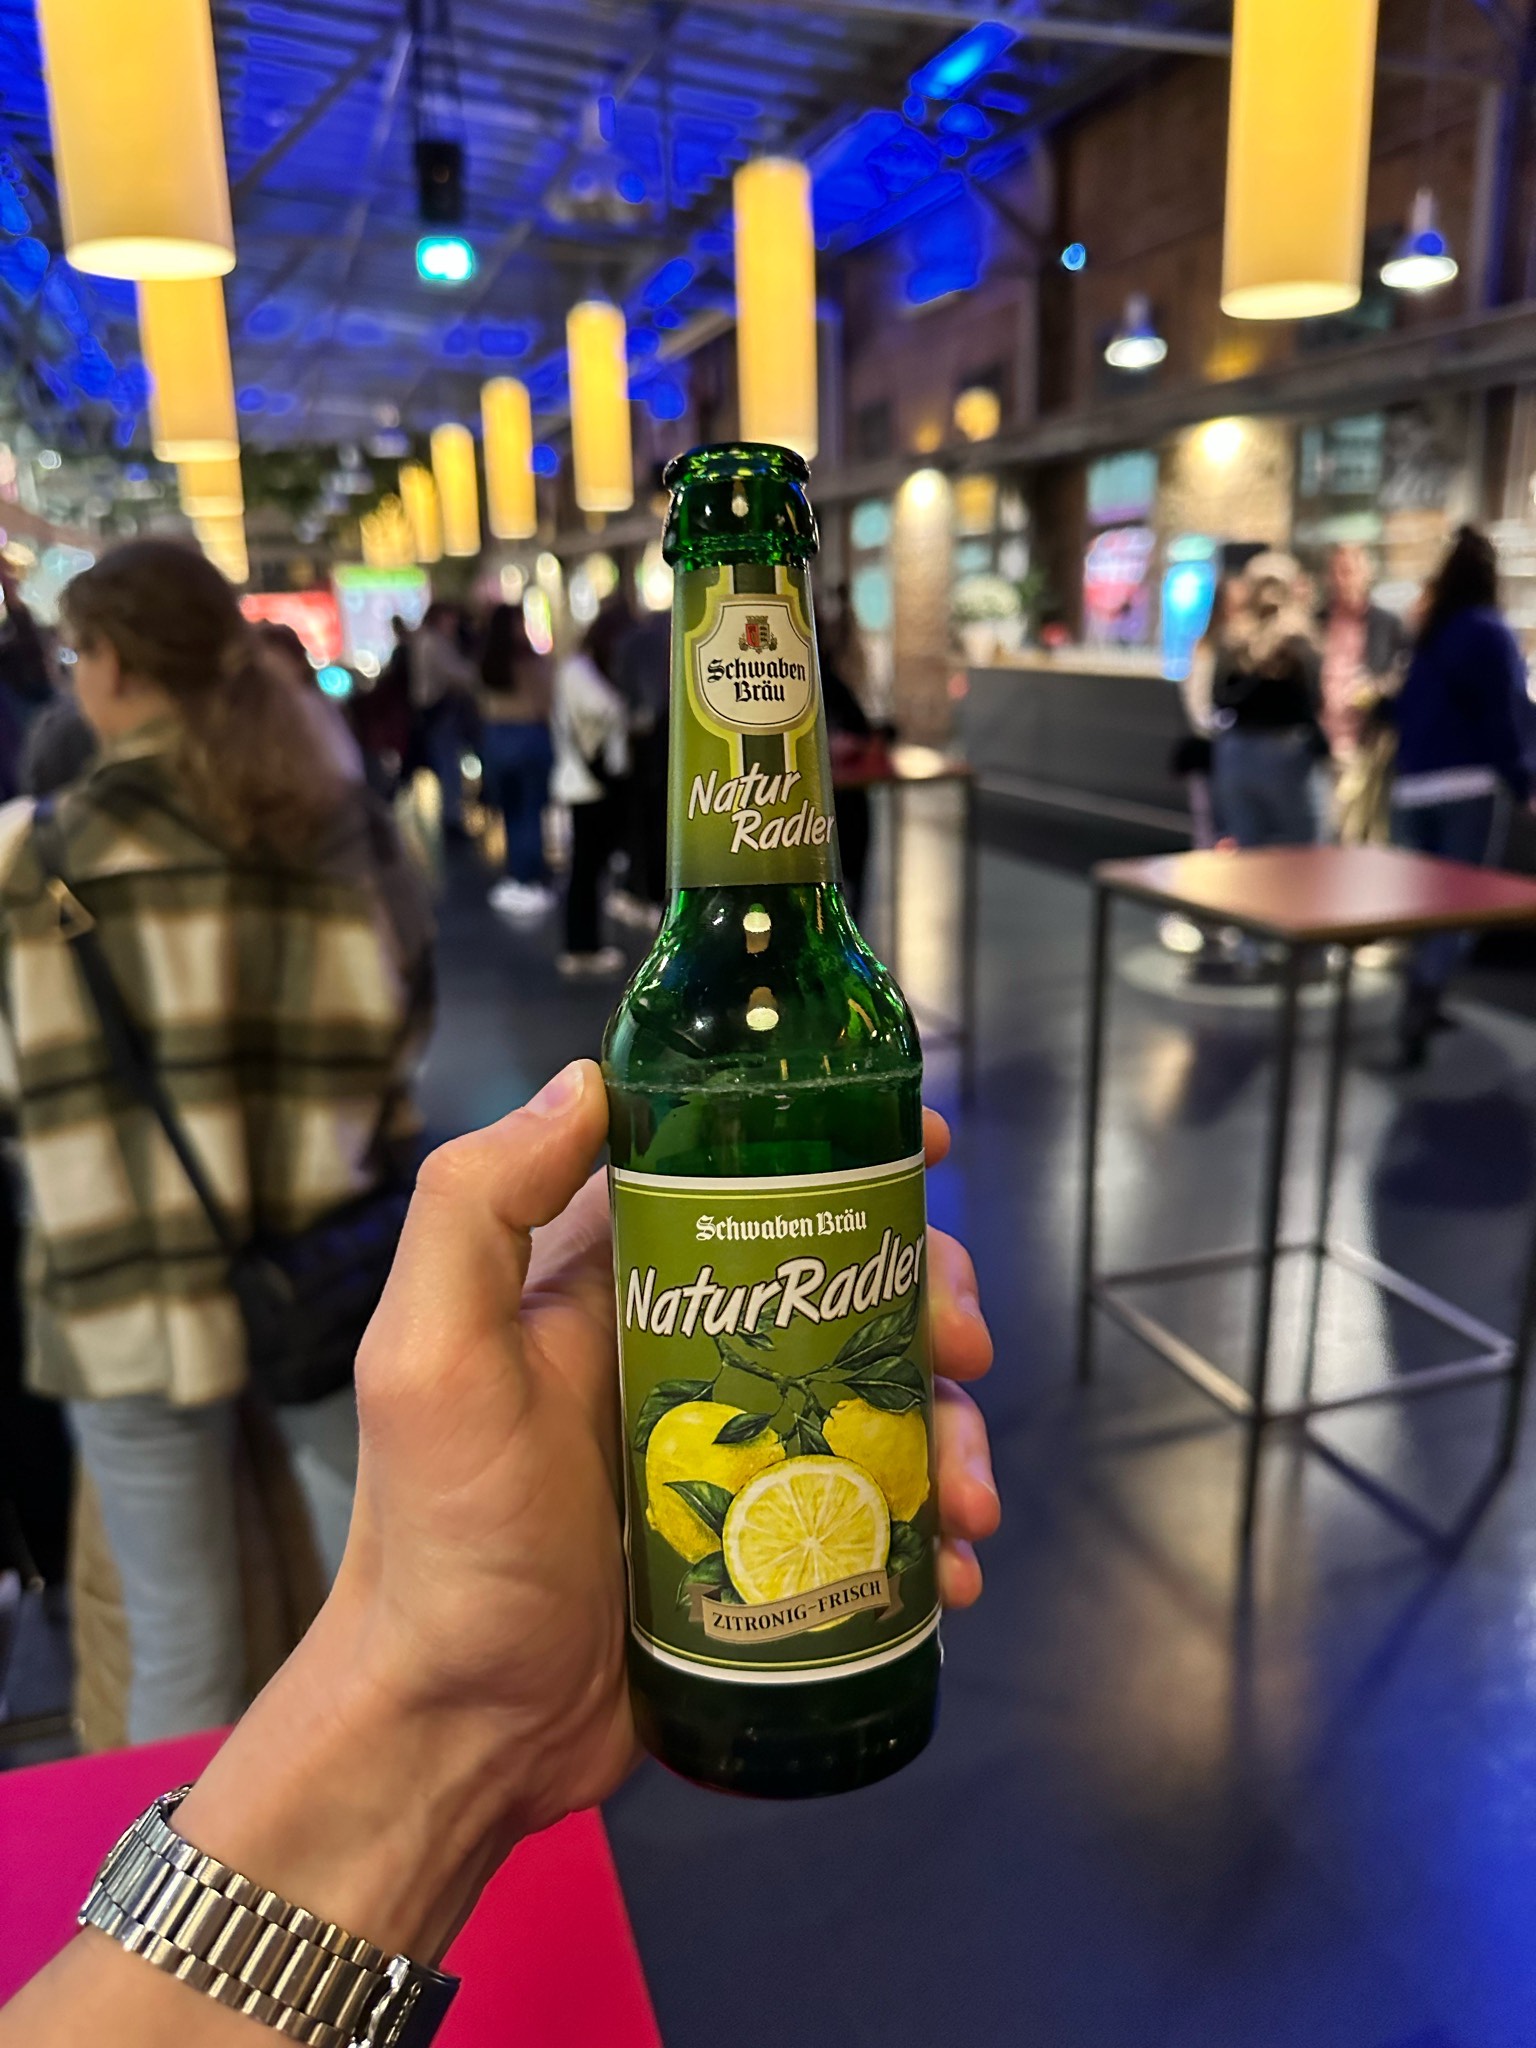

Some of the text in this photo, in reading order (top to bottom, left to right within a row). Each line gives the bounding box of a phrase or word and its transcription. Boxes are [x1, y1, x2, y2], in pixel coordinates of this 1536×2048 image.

[707, 657, 806, 683] Schwaben
[733, 680, 785, 702] Bräu
[688, 762, 802, 821] Natur
[730, 799, 835, 854] Radler
[695, 1208, 867, 1241] Schwaben Bräu
[712, 1580, 882, 1632] ZITRONIG-FRISCH
